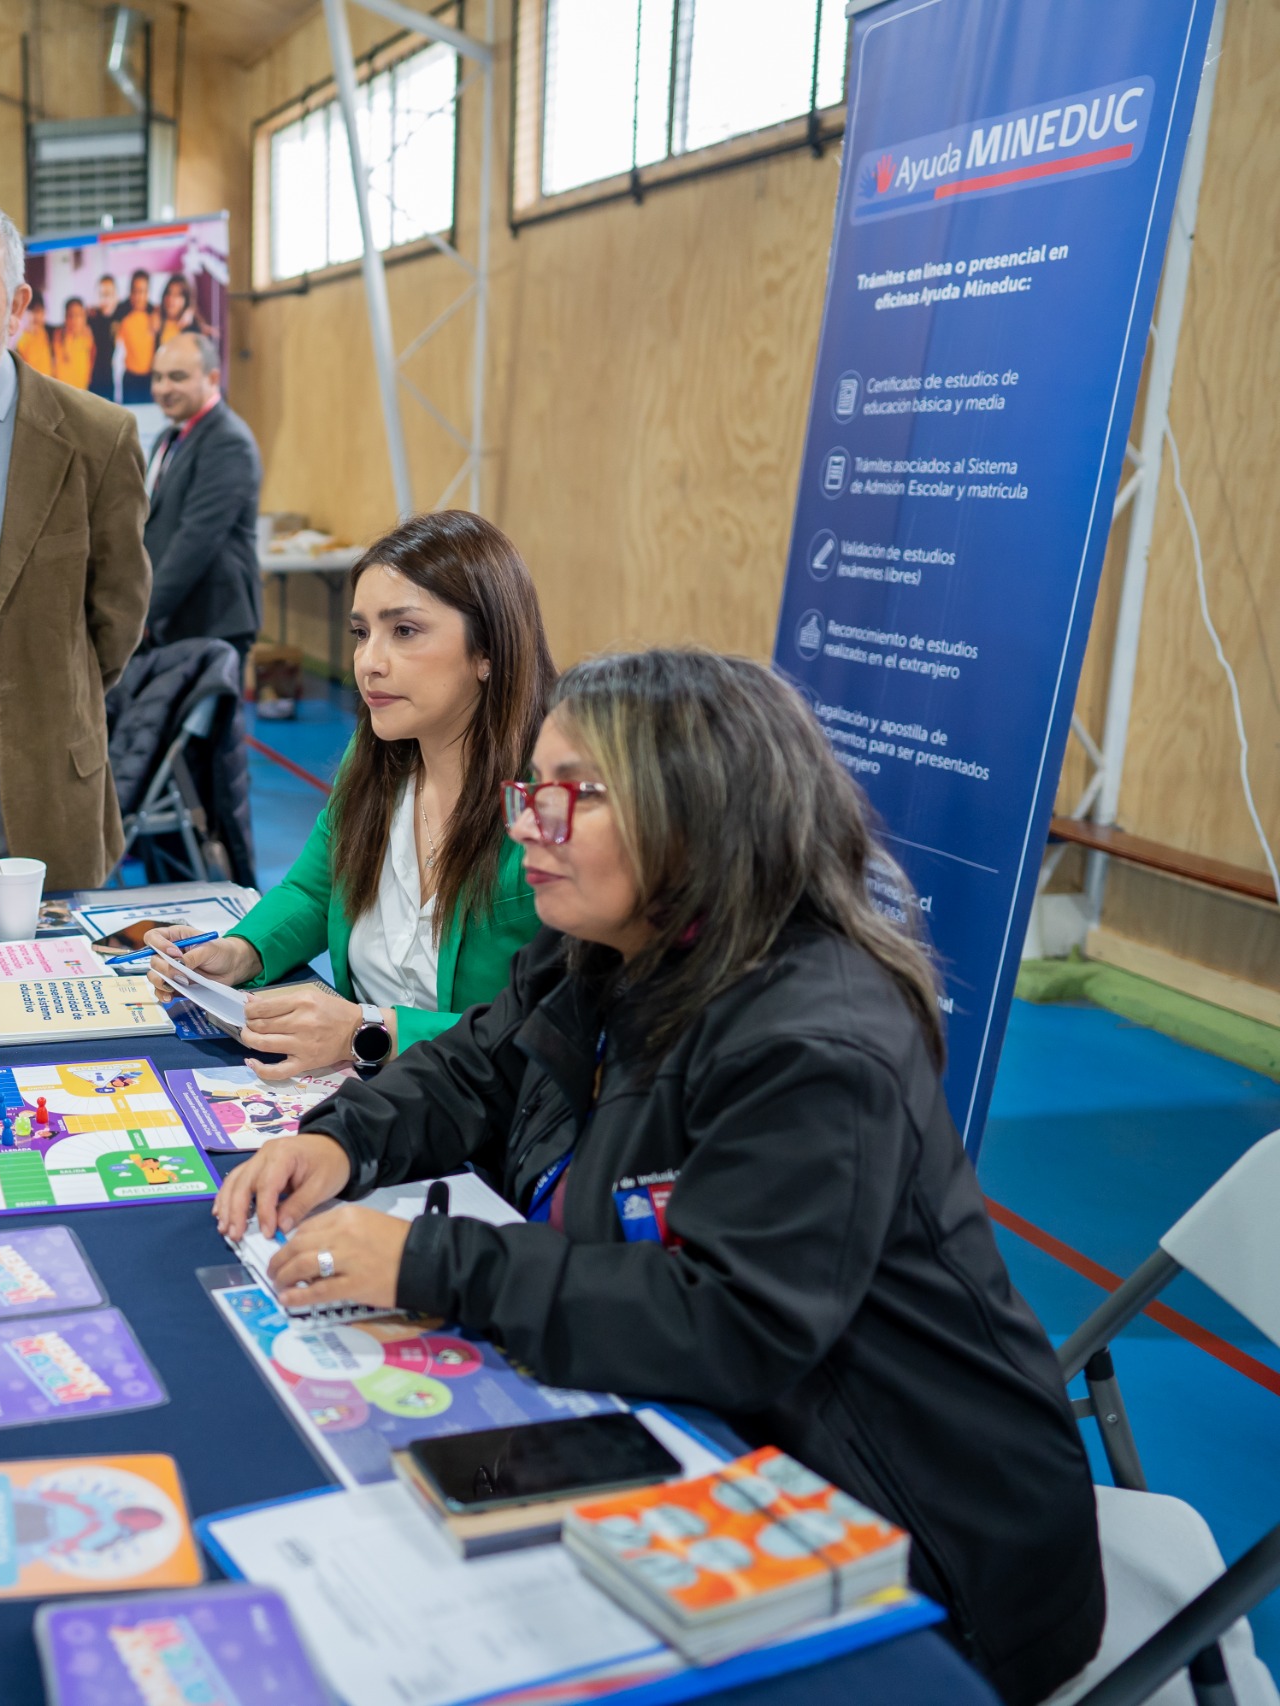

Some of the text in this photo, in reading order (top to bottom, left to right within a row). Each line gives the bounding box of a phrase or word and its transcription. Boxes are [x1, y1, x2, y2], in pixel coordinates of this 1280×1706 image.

[895, 87, 1145, 192] Ayuda MINEDUC
[857, 246, 1069, 290] Trámites en línea o presencial en
[920, 283, 961, 306] Ayuda
[962, 276, 1032, 298] Mineduc:
[866, 369, 1019, 394] Certificados de estudios de
[863, 394, 1006, 416] educación básica y media
[855, 456, 1018, 475] Trámites asociados al Sistema
[850, 479, 1029, 501] de Admisión Escolar y matrícula
[840, 539, 956, 566] Validación de estudios
[827, 620, 979, 660] Reconocimiento de estudios
[823, 643, 960, 680] realizados en el extranjero
[869, 718, 880, 733] y
[880, 719, 928, 743] apostilla
[930, 729, 948, 746] de
[868, 739, 896, 757] para
[897, 745, 915, 761] ser
[916, 748, 990, 781] presentados
[5, 945, 23, 969] educación
[17, 944, 34, 965] para una
[19, 983, 36, 1013] educativo
[38, 997, 52, 1021] sistema
[48, 982, 65, 1014] enseñanza
[62, 981, 83, 1012] diversidad
[76, 981, 94, 1010] reconocer
[90, 980, 111, 1015] Claves para
[72, 1012, 84, 1021] de
[15, 1200, 49, 1208] SEGURO
[10, 1335, 93, 1405] MATCH
